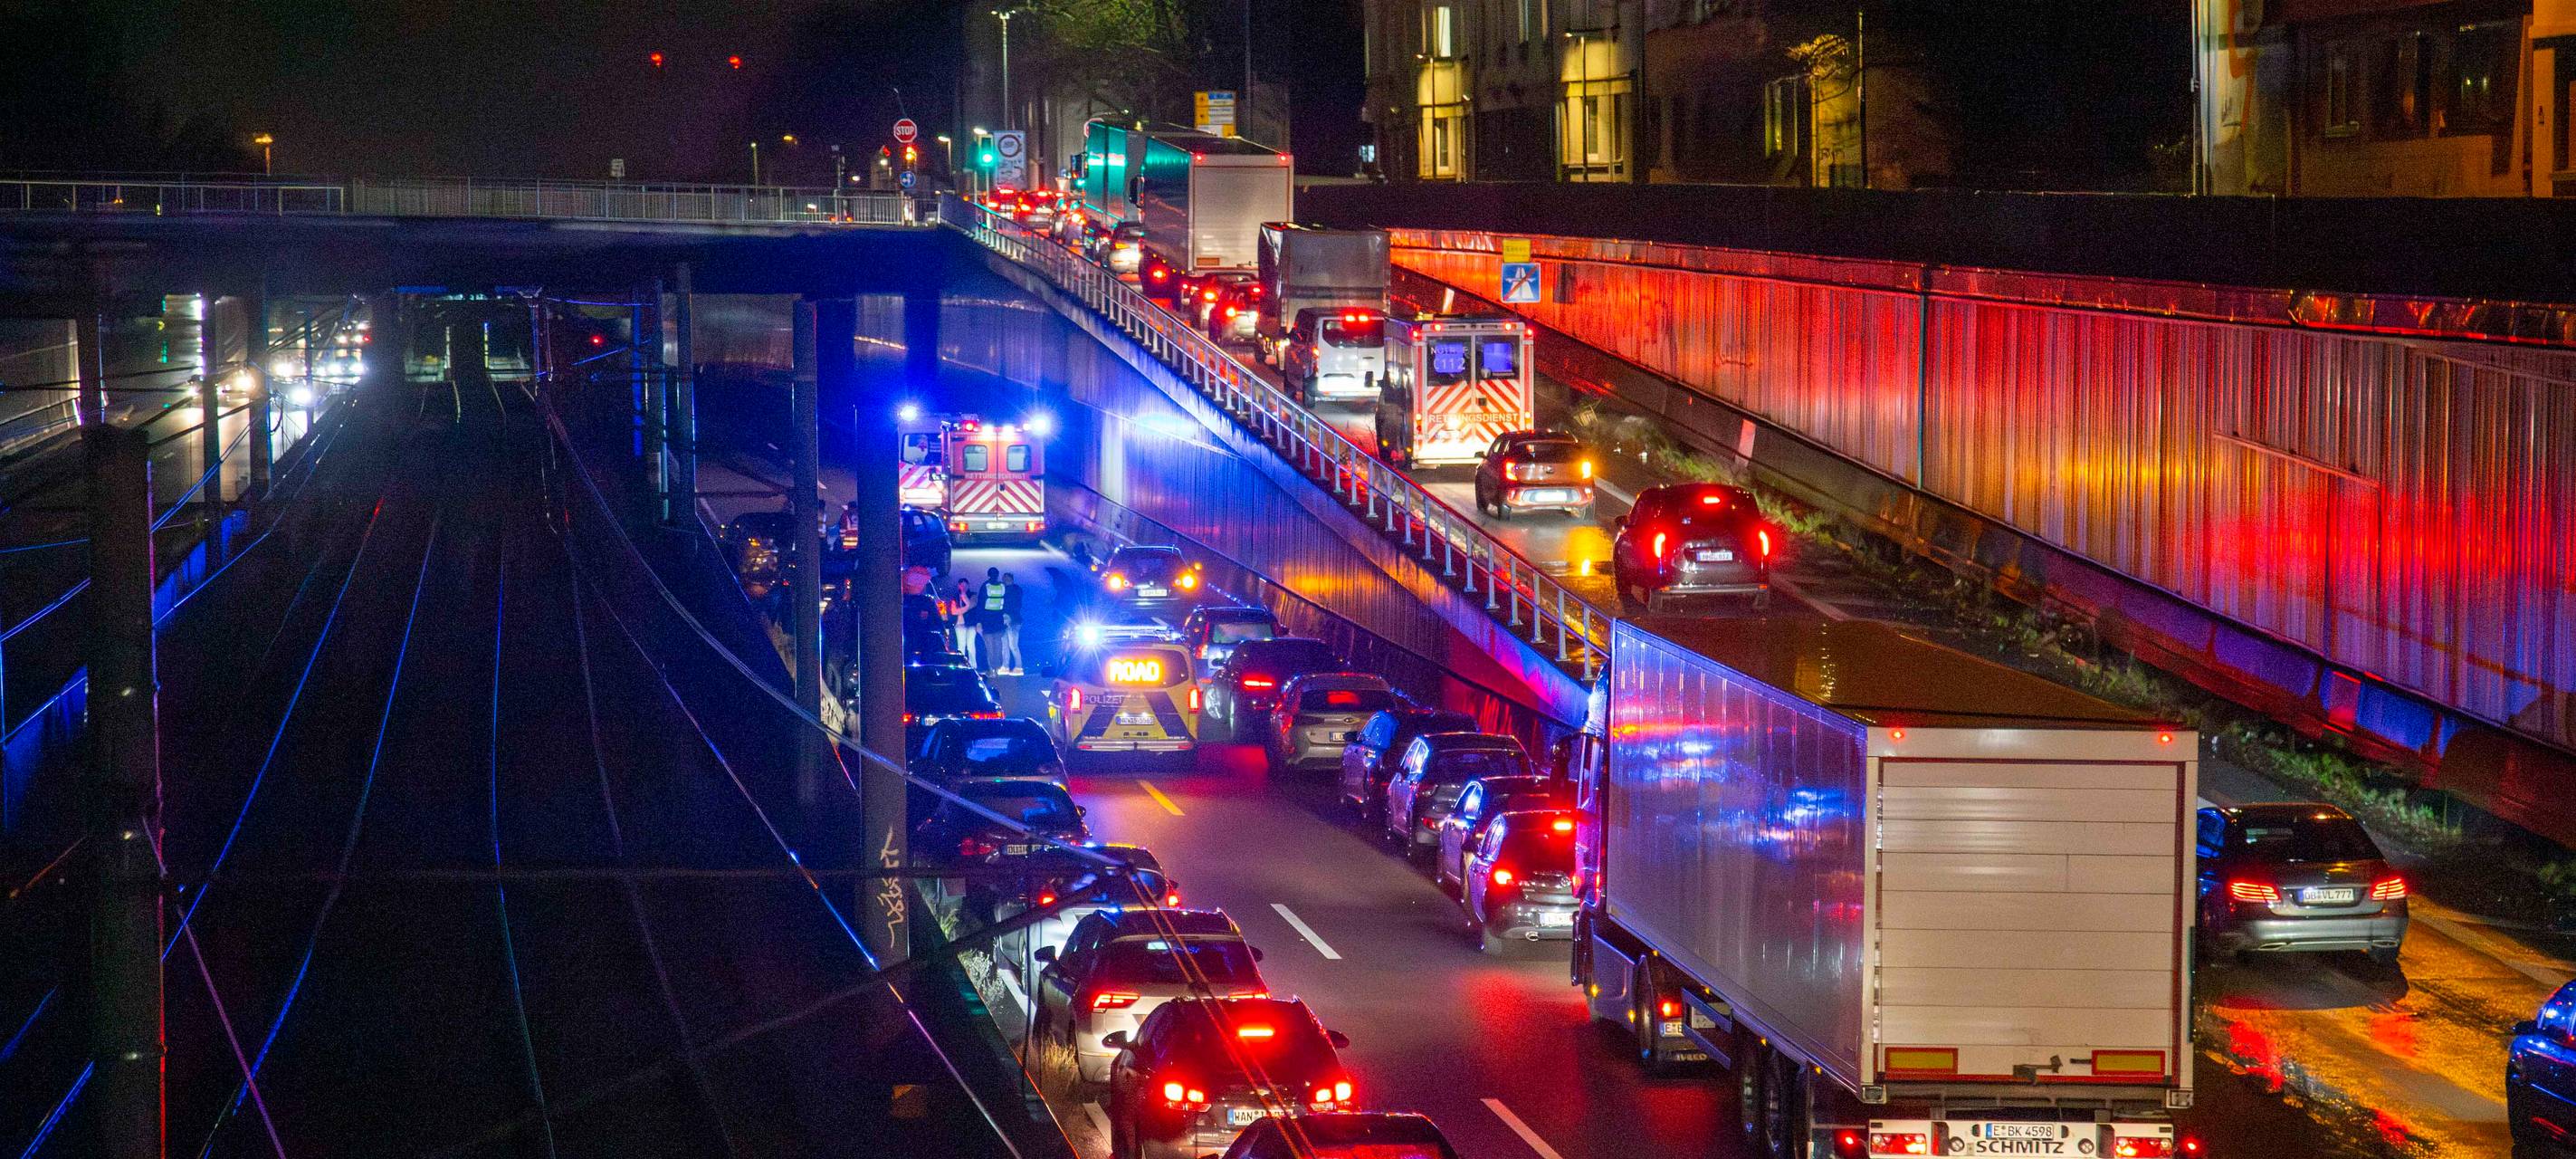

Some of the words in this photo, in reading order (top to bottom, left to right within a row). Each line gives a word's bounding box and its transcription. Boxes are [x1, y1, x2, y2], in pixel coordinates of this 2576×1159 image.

[896, 126, 914, 135] STOP
[1442, 358, 1465, 370] 112
[1110, 660, 1159, 682] ROAD
[2335, 890, 2352, 899] 777
[1235, 1110, 1253, 1122] WAN
[1994, 1125, 2000, 1136] E
[2008, 1125, 2022, 1137] BK
[2025, 1125, 2053, 1137] 4598
[1976, 1140, 2065, 1154] SCHMITZ
